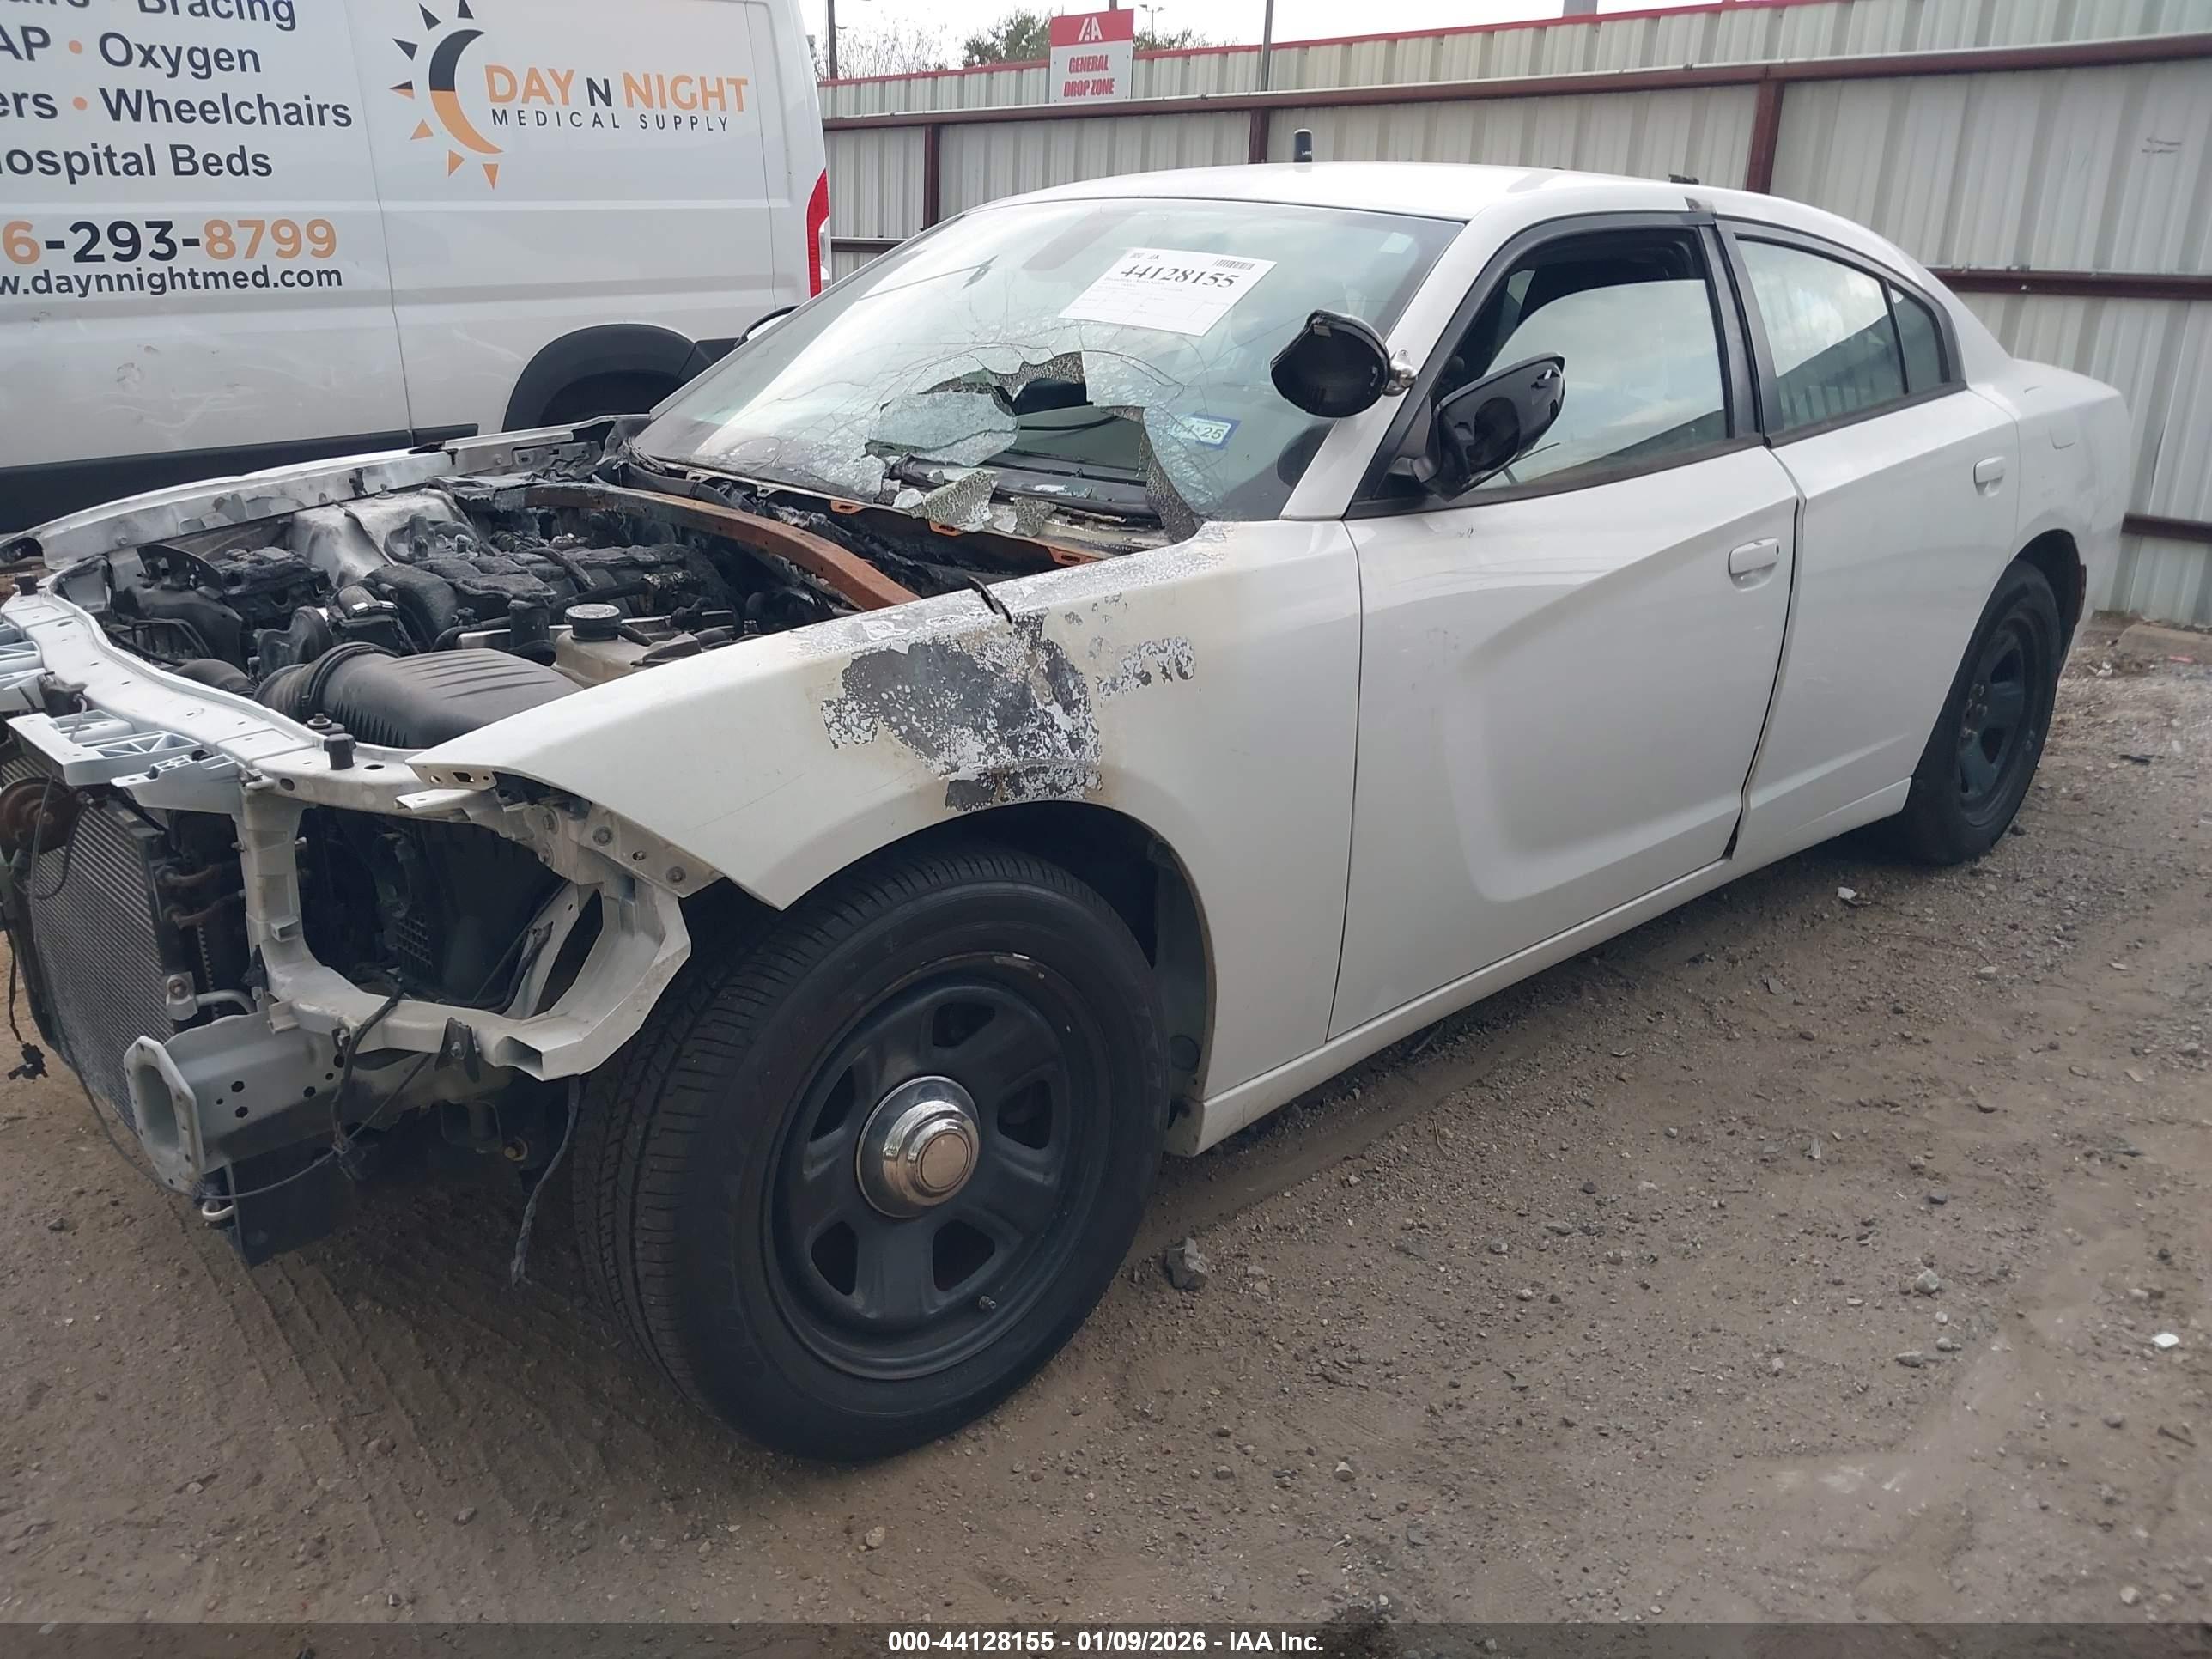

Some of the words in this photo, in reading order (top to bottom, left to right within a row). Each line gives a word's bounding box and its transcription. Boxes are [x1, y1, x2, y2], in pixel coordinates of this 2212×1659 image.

[99, 33, 260, 79] Oxygen
[1069, 55, 1109, 74] GENERAL
[484, 64, 574, 106] DAY
[586, 77, 612, 107] N
[622, 71, 748, 112] NIGHT
[1064, 81, 1090, 97] DROP
[1091, 78, 1115, 96] ZONE
[99, 88, 353, 128] Wheelchairs
[492, 109, 619, 129] MEDICAL
[640, 114, 728, 131] SUPPLY
[0, 143, 156, 184] ospital
[170, 144, 273, 177] Beds
[1121, 264, 1240, 288] 44128155
[1200, 427, 1223, 440] 25
